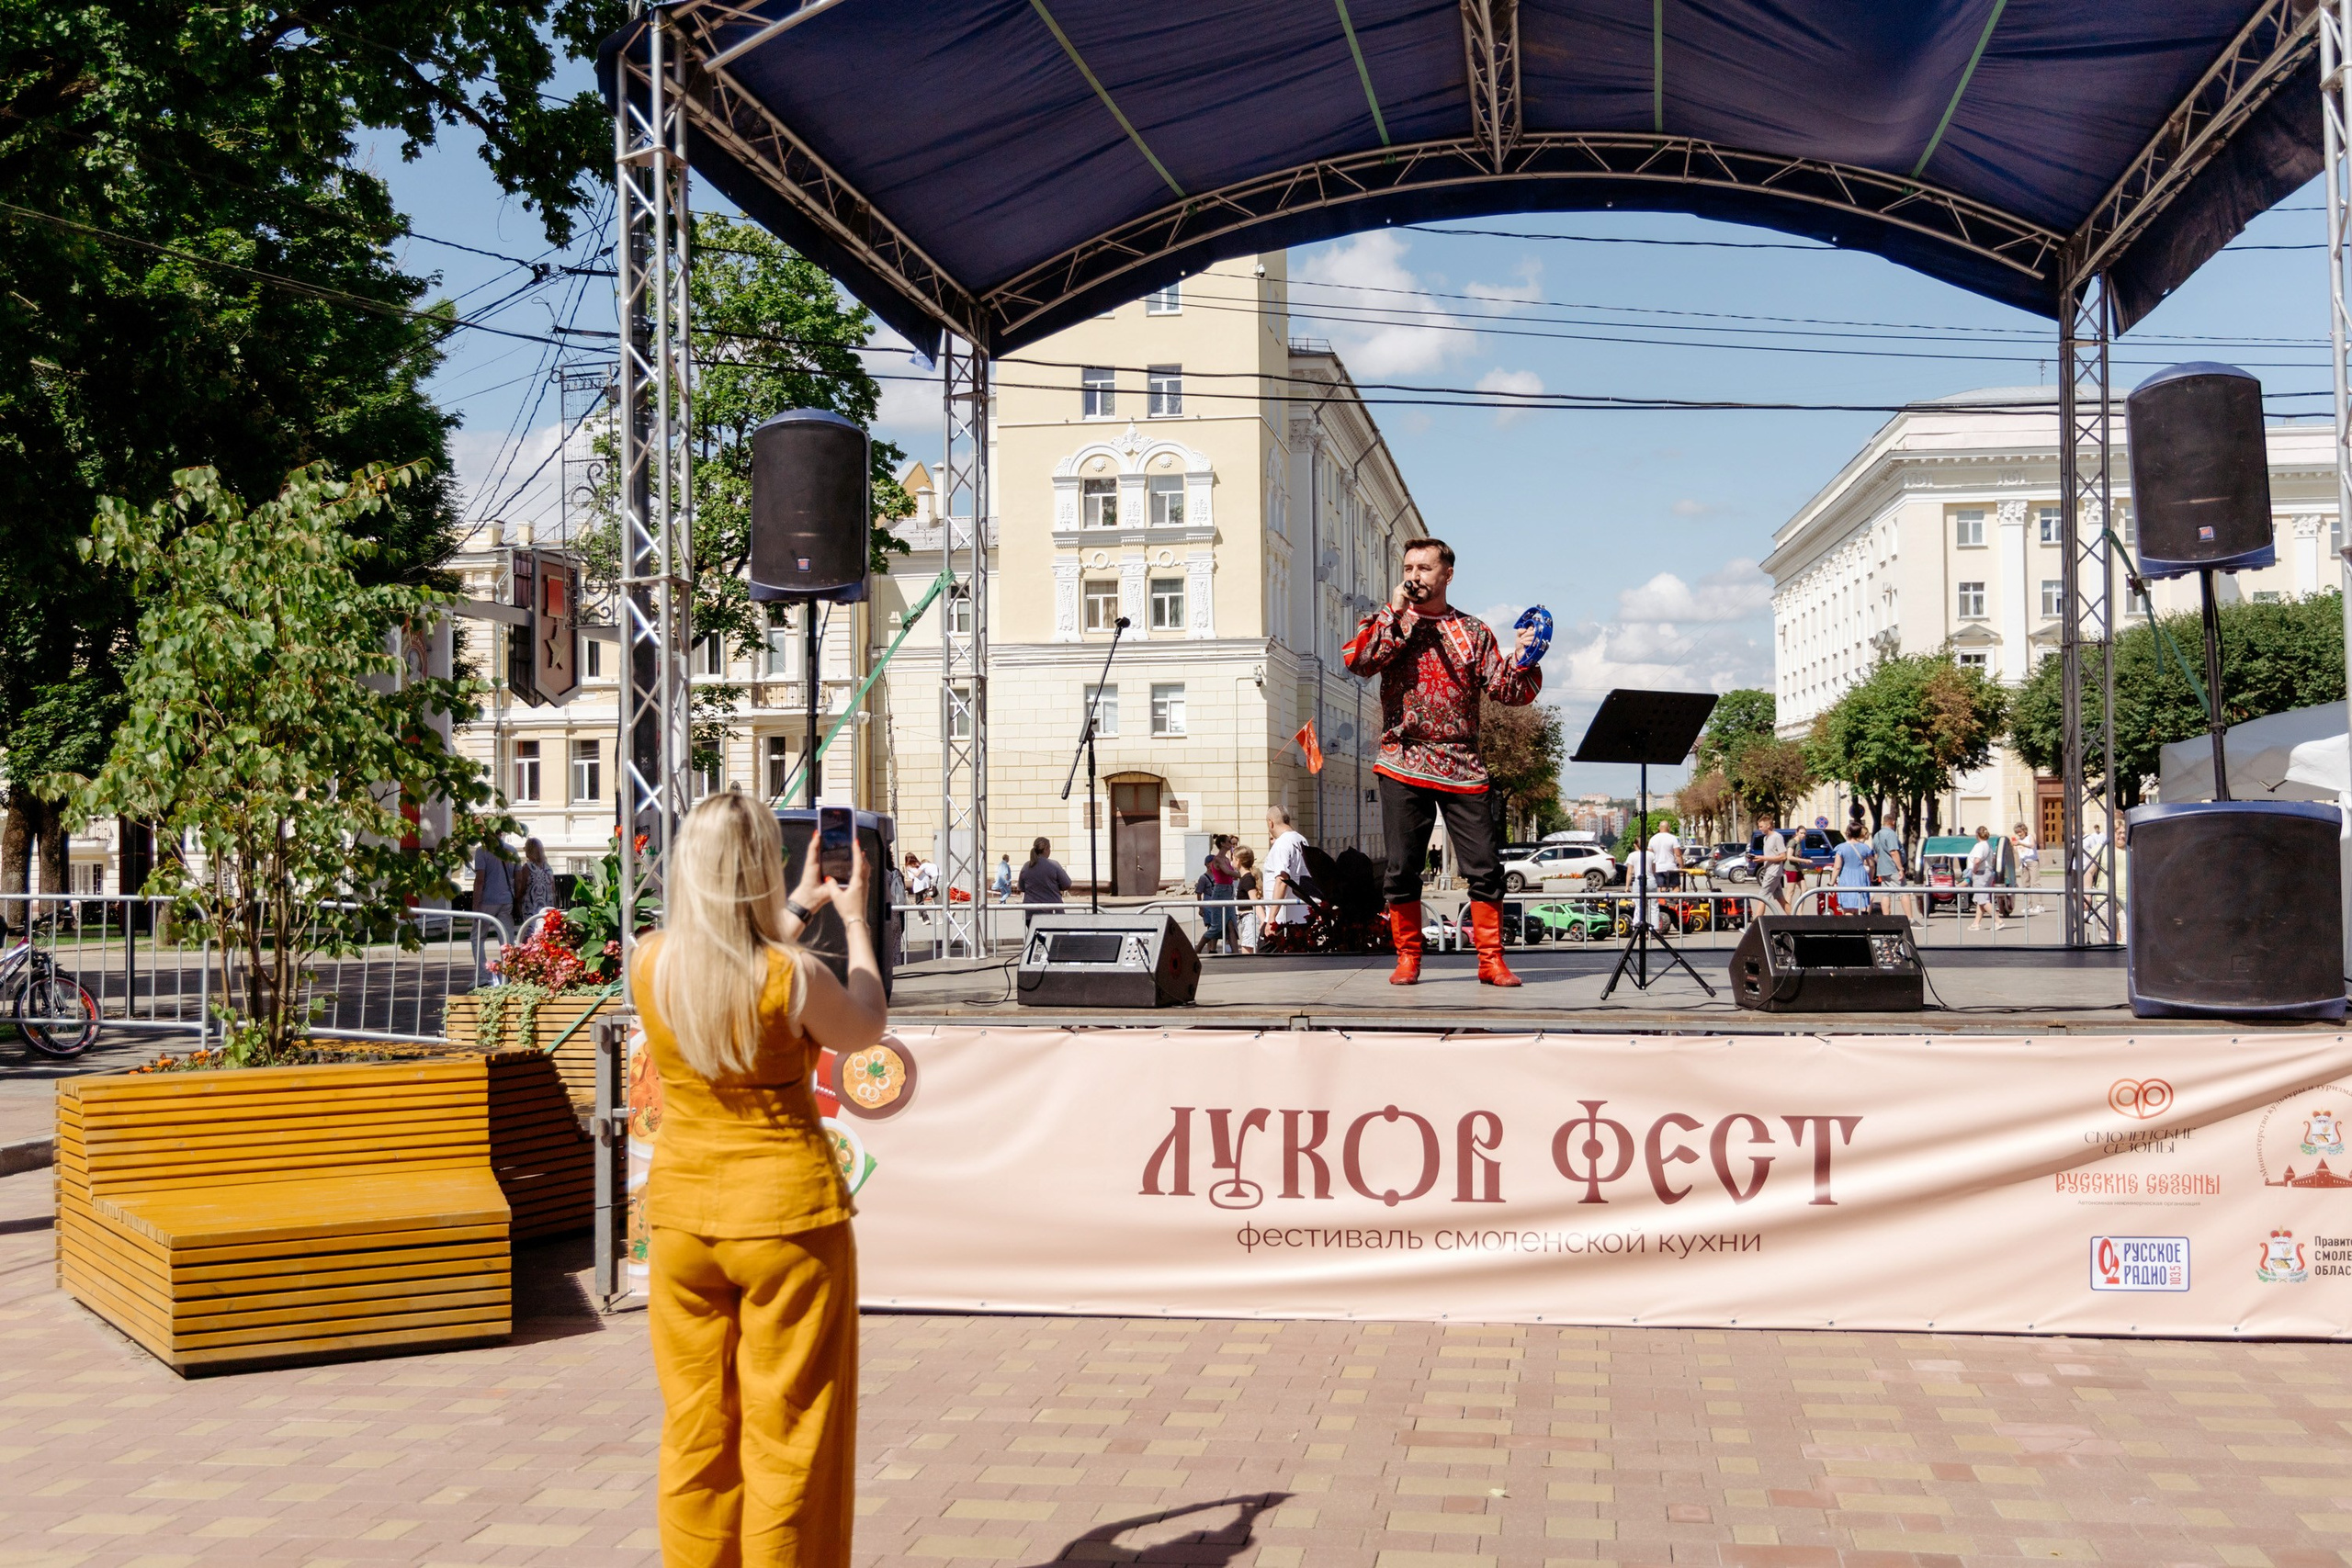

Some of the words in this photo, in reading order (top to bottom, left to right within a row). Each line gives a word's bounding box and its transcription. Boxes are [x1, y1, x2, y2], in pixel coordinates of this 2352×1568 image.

[2267, 1088, 2306, 1115] культуры
[2084, 1127, 2196, 1145] СМОЛЕНСКИЕ
[1551, 1100, 1865, 1206] ФЕСТ
[2104, 1141, 2175, 1154] СЕЗОНЫ
[2055, 1171, 2139, 1194] РУССКИЕ
[2146, 1173, 2221, 1195] СЕЗОНЫ
[1237, 1221, 1423, 1253] фестиваль
[1434, 1226, 1645, 1254] смоленской
[1658, 1233, 1761, 1259] кухни
[2314, 1235, 2352, 1248] Правит
[2123, 1243, 2181, 1263] РУССКОЕ
[2123, 1265, 2167, 1285] РАДИО
[2169, 1265, 2182, 1285] 103.5
[2314, 1265, 2352, 1276] ОБЛАС
